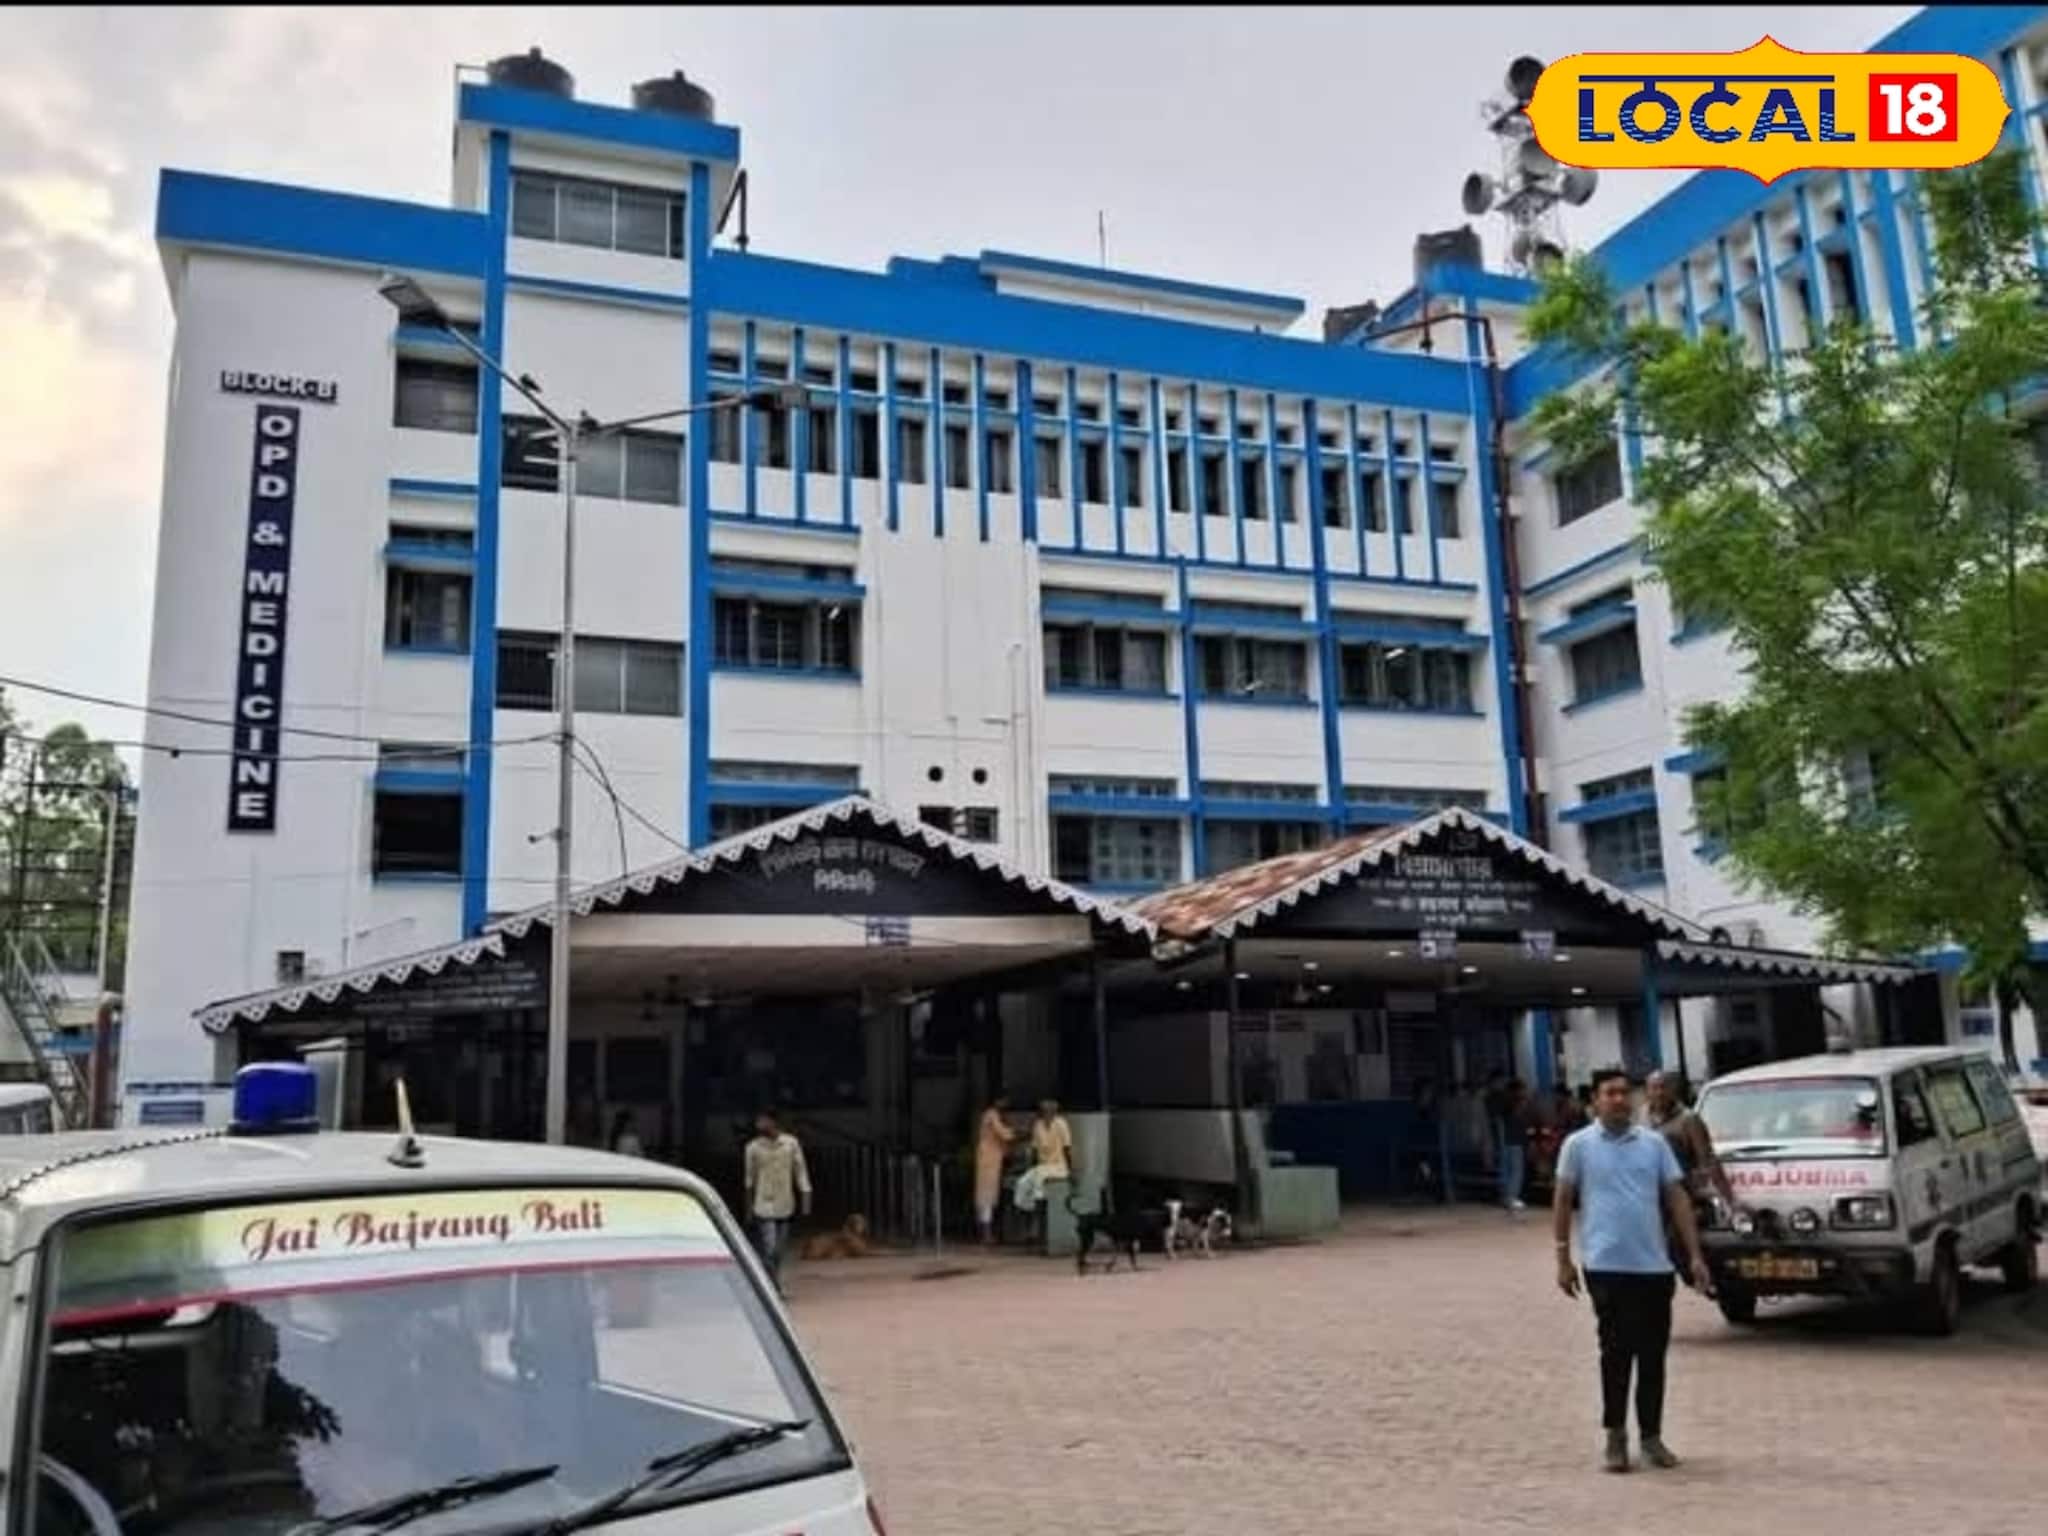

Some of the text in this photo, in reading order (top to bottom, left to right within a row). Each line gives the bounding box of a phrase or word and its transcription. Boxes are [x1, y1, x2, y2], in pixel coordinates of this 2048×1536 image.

[220, 369, 338, 404] BLOCK-B
[236, 414, 294, 819] OPD & MEDICINE
[241, 1218, 319, 1261] Jai
[521, 1199, 605, 1232] Bali
